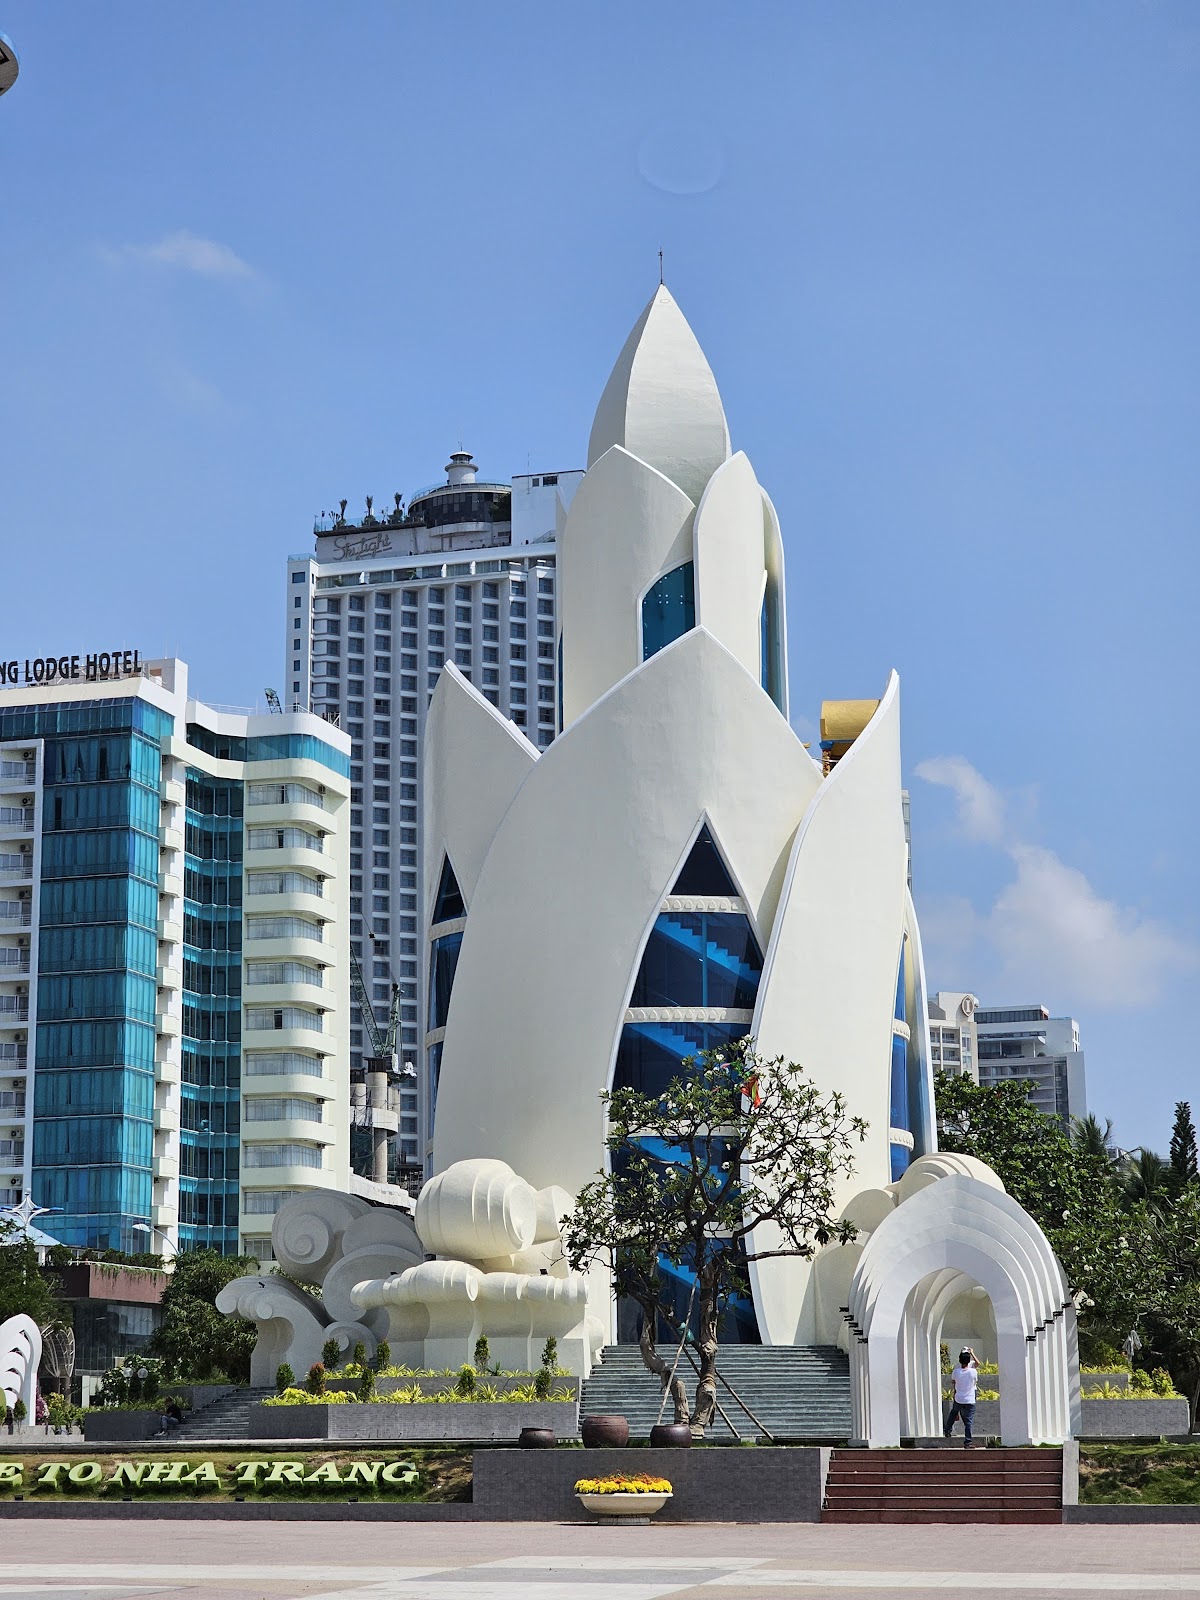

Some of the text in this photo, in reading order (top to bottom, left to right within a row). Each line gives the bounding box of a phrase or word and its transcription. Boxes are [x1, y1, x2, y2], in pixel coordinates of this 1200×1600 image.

[25, 655, 80, 682] LODGE
[86, 650, 142, 681] HOTEL
[0, 1462, 420, 1485] E TO NHA TRANG
